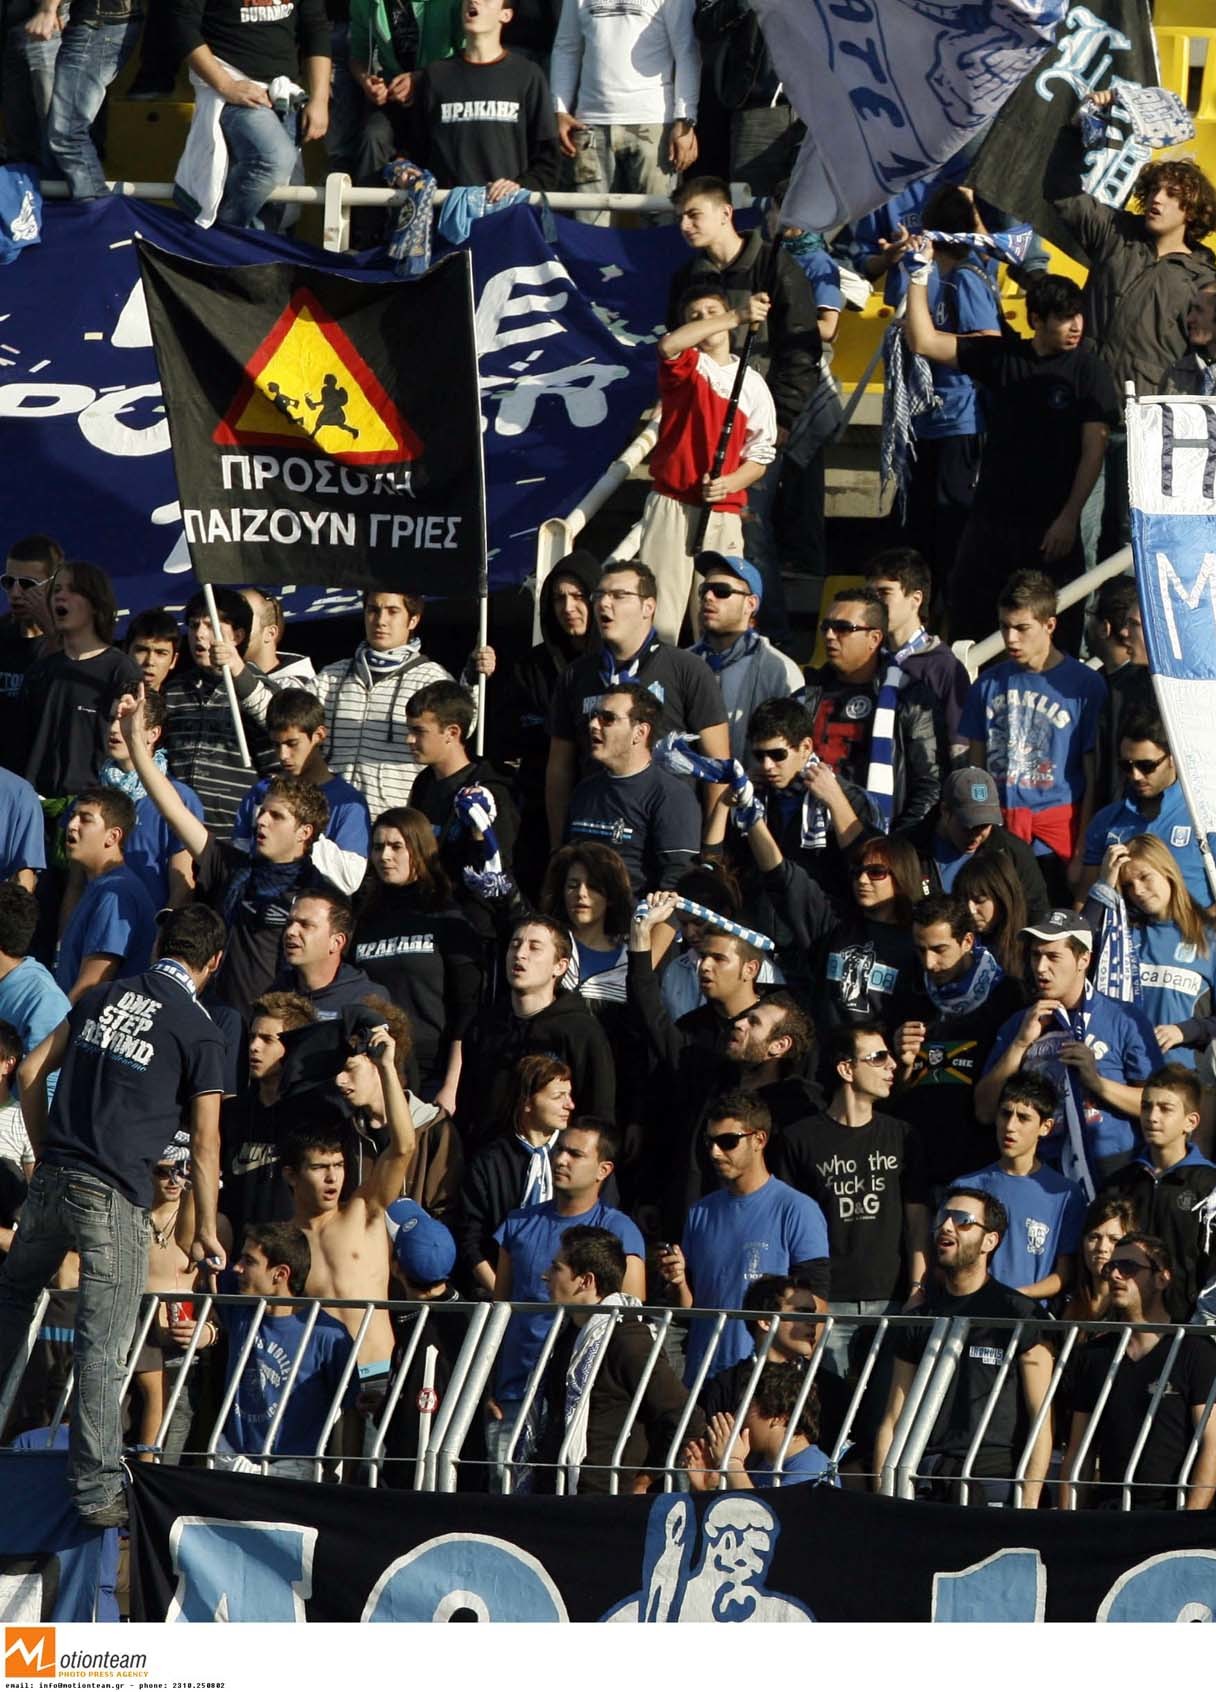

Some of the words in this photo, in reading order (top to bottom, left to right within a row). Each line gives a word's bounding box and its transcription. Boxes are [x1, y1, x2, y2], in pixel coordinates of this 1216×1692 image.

[441, 101, 520, 122] ΗΡΑΚΛΗΣ
[183, 507, 357, 547] ΠΑΙΖΟΥΝ
[369, 513, 462, 549] ΓΡΙΕΣ
[1163, 969, 1201, 990] bank
[117, 991, 163, 1019] ONE
[99, 1004, 154, 1037] STEP
[816, 1154, 857, 1177] who
[868, 1150, 899, 1171] the
[825, 1175, 866, 1195] fuck
[871, 1174, 886, 1192] is
[839, 1193, 881, 1219] D&G
